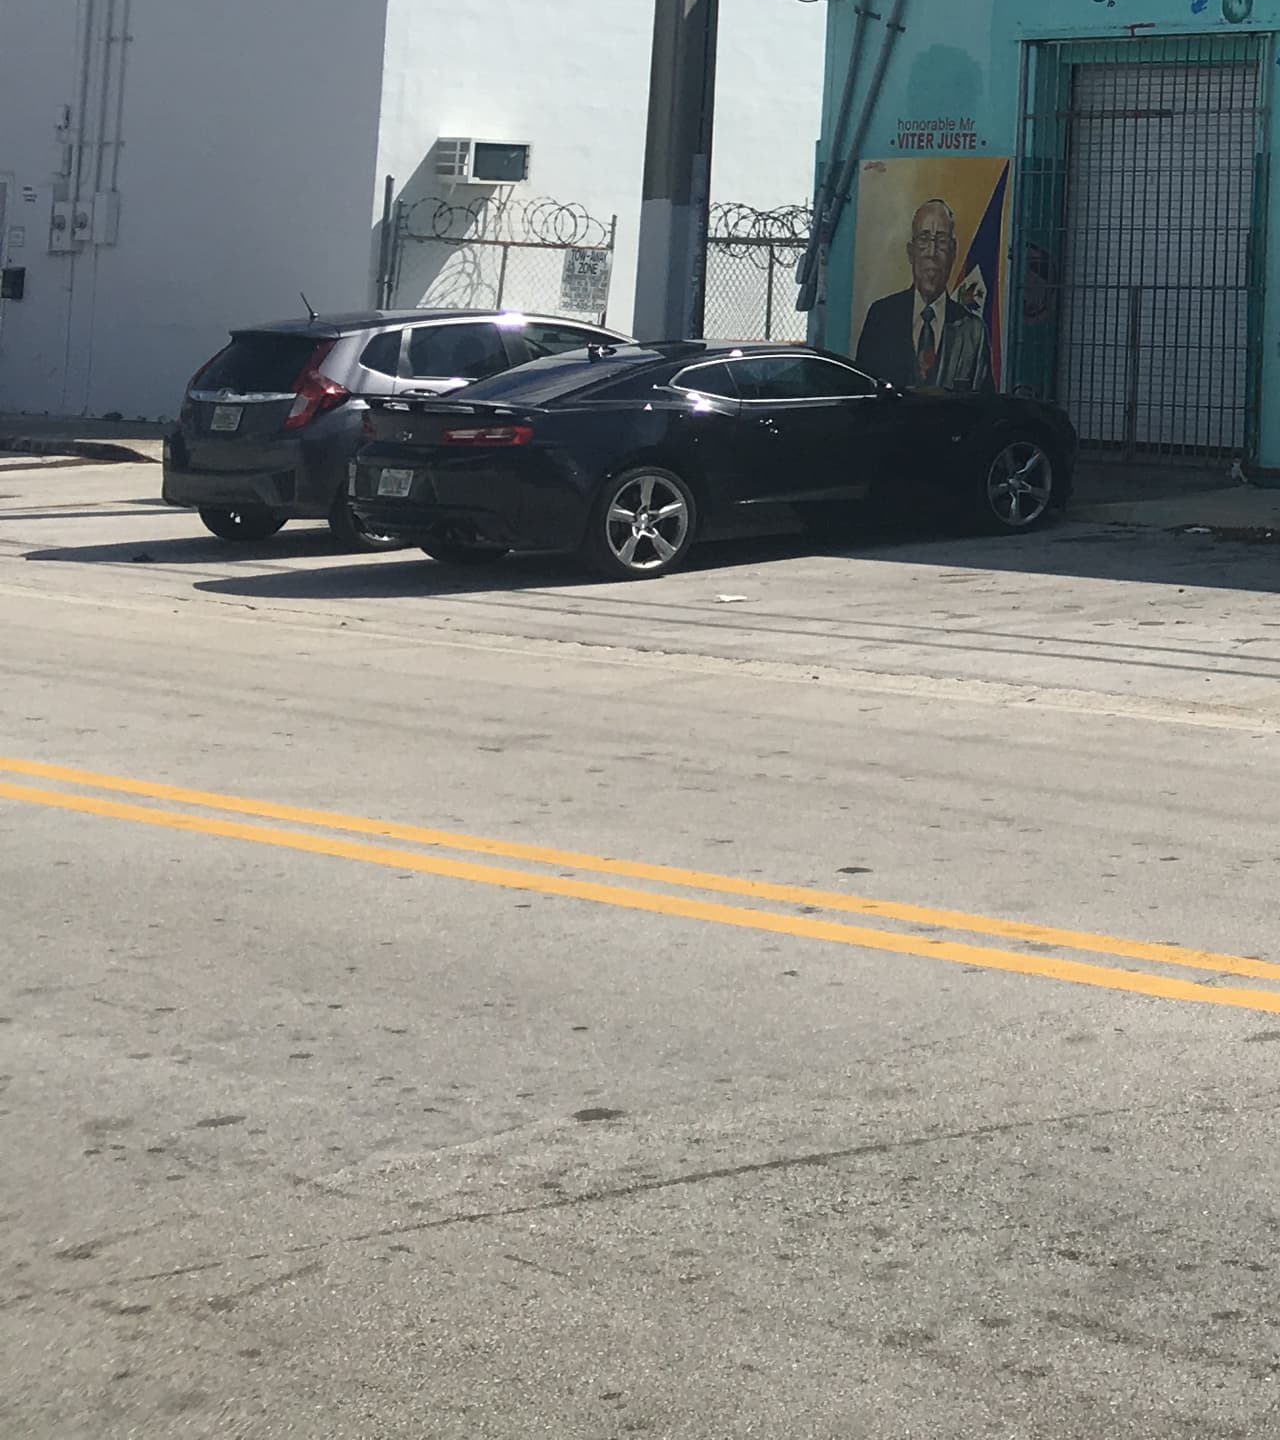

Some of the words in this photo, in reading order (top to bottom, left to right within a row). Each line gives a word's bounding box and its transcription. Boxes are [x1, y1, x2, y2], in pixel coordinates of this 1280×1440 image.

[898, 133, 934, 149] VITER
[938, 133, 977, 149] JUSTE
[578, 262, 599, 275] ZONE
